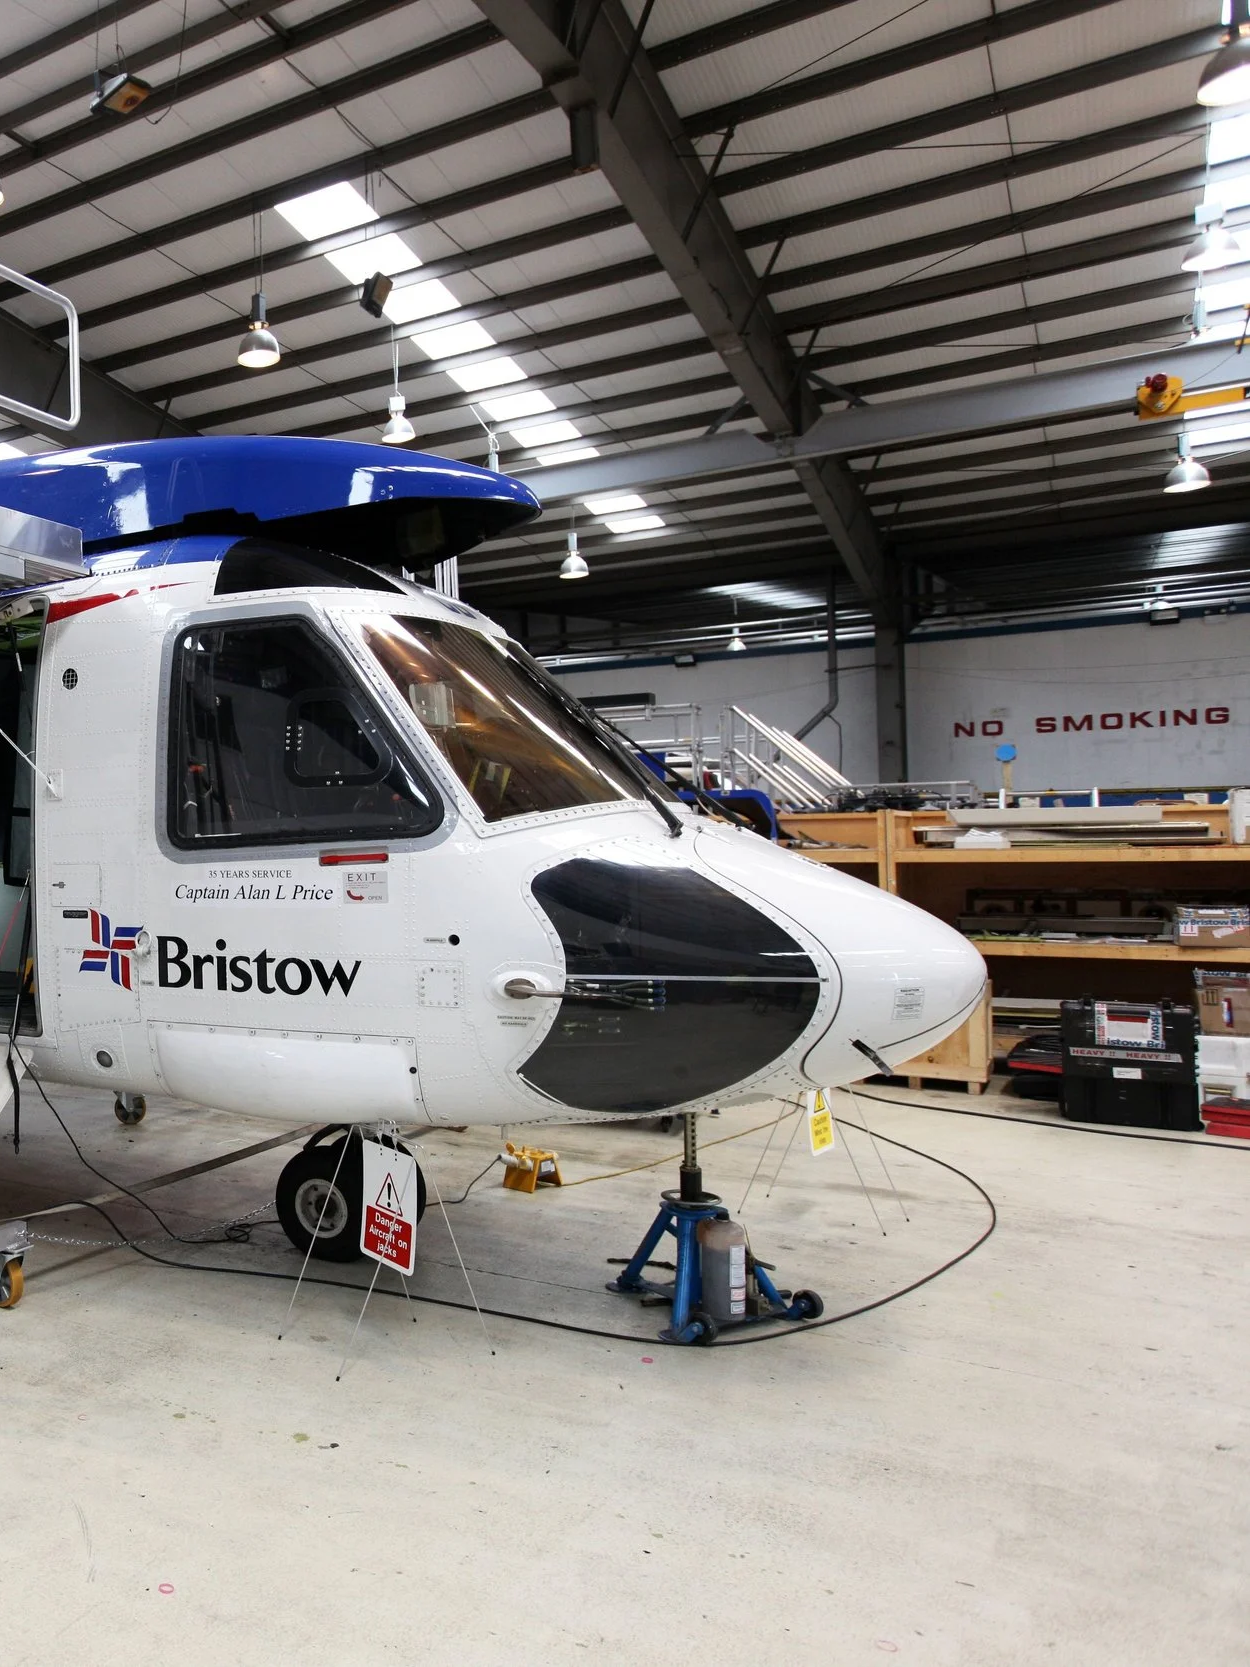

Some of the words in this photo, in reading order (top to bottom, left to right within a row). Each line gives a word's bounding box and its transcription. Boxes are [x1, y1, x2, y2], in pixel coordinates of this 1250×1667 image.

[953, 720, 1004, 738] NO
[1035, 706, 1230, 734] SMOKING
[208, 870, 217, 879] 35
[219, 869, 250, 879] YEARS
[251, 869, 292, 879] SERVICE
[347, 872, 376, 882] EXIT
[175, 884, 230, 903] Captain
[234, 884, 270, 900] Alan
[275, 884, 286, 900] L
[292, 884, 333, 900] Price
[156, 935, 362, 998] Bristow
[1072, 1048, 1105, 1057] HEAVY
[1126, 1051, 1160, 1060] HEAVY
[375, 1212, 402, 1232] Danger
[369, 1224, 395, 1244] Aircraft
[397, 1239, 408, 1250] on
[377, 1240, 397, 1258] jacks
